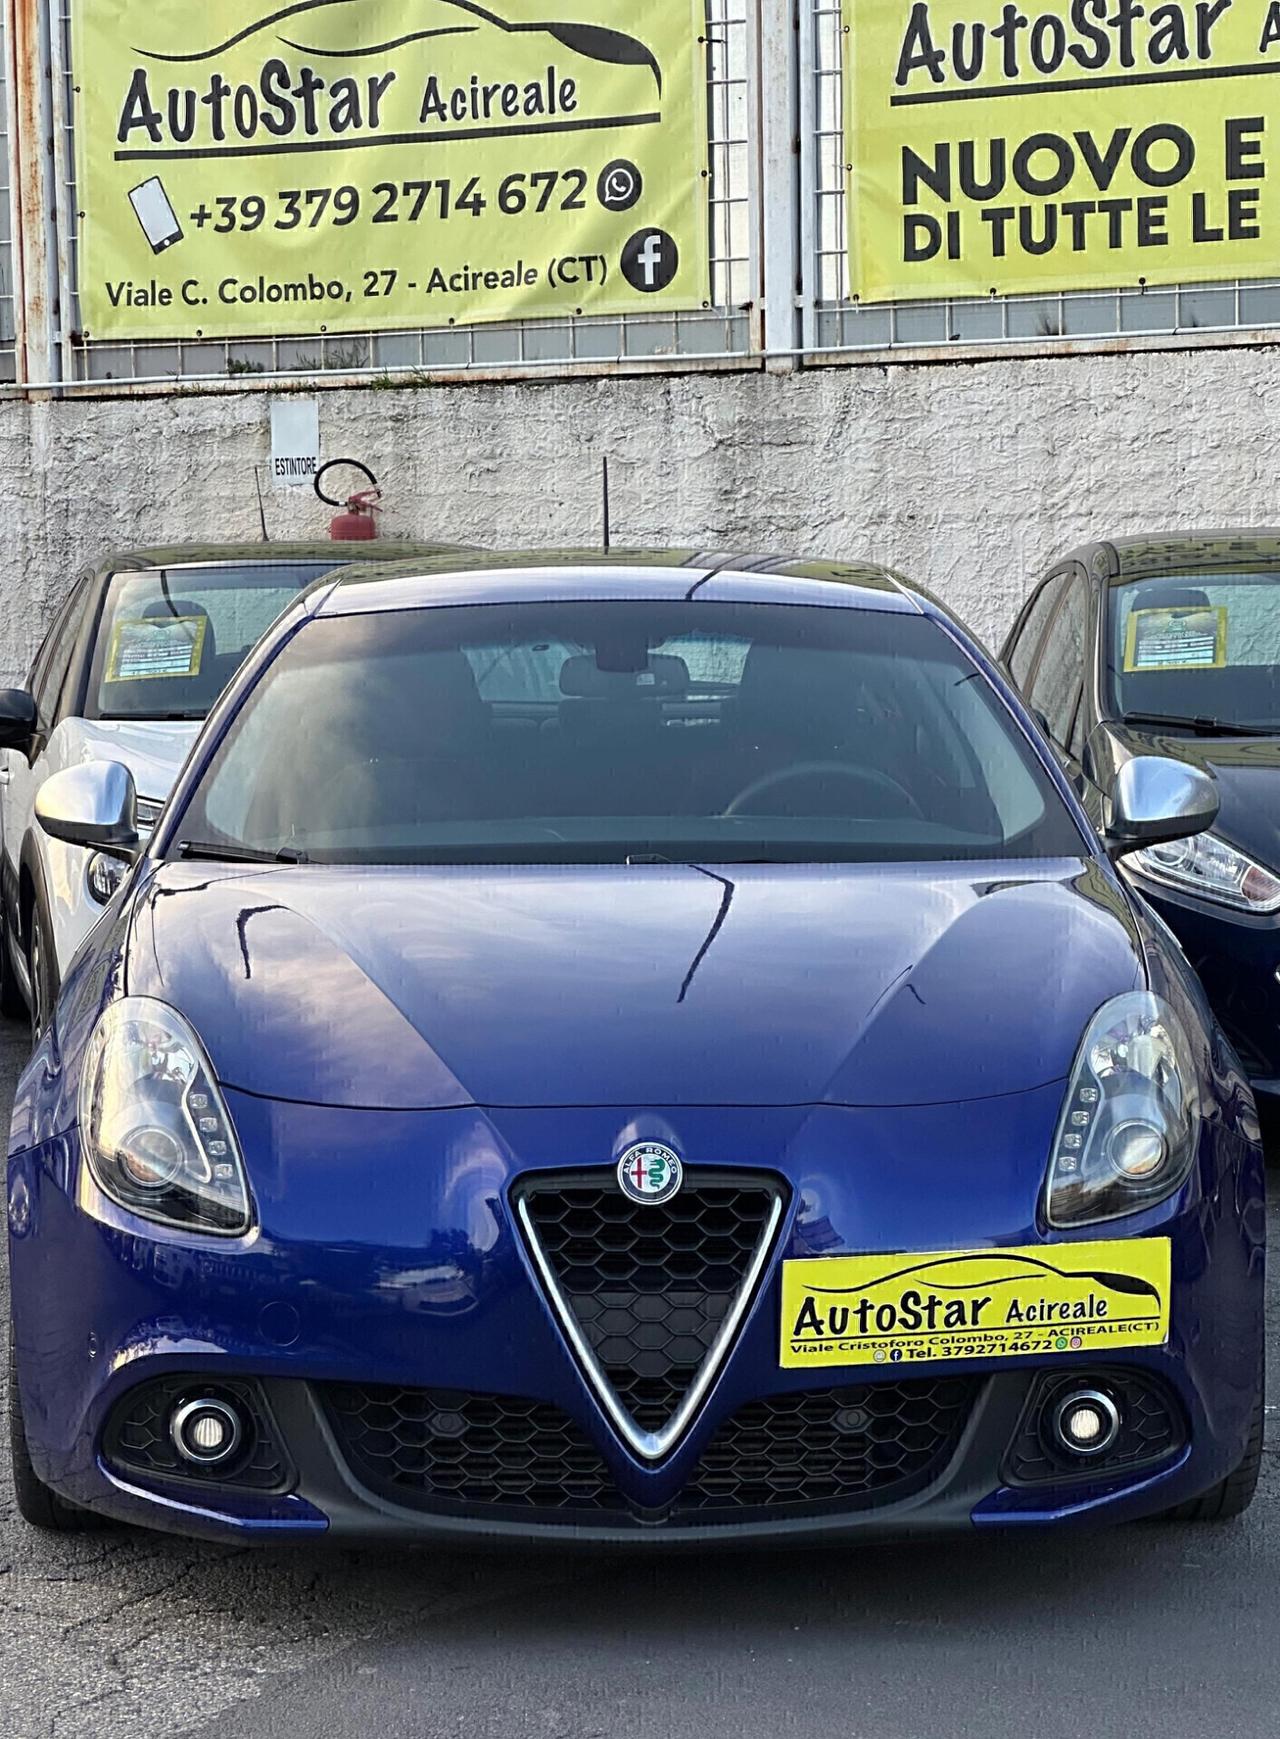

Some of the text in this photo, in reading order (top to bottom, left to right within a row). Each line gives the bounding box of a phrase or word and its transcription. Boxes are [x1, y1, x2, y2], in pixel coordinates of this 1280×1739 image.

[895, 0, 1232, 86] AutoStar
[116, 58, 578, 143] AutoStar Acireale
[902, 116, 1265, 205] NUOVO E
[190, 169, 588, 233] +39 379 2714 672
[903, 188, 1260, 262] DI TUTTE LE
[105, 280, 173, 307] Viale
[181, 279, 208, 305] C.
[218, 273, 352, 304] Colombo,
[363, 269, 398, 297] 27
[425, 260, 538, 293] Acireale
[547, 254, 607, 288] (CT)
[275, 457, 318, 475] ESTINTORE
[623, 1147, 677, 1175] ALFA ROMEO
[790, 1343, 834, 1354] Viale
[838, 1338, 924, 1351] Cristoforo
[928, 1330, 1009, 1346] Colombo,
[1013, 1330, 1034, 1340] 27
[1048, 1321, 1160, 1338] ACIREALE(CT)
[793, 1290, 1108, 1337] AutoStar Acireale
[907, 1346, 937, 1359] Tel.
[941, 1339, 1052, 1358] 3792714672
